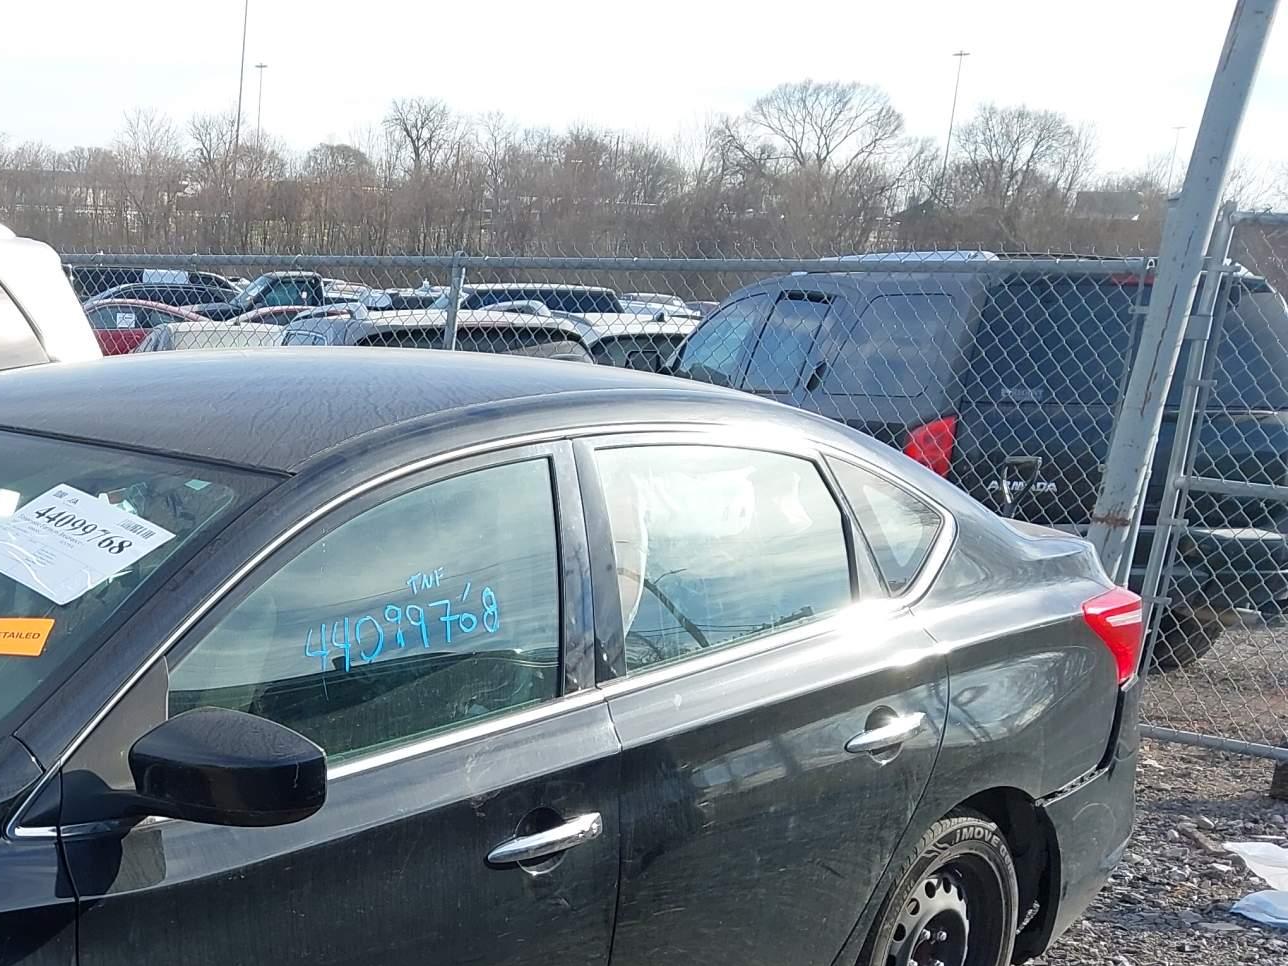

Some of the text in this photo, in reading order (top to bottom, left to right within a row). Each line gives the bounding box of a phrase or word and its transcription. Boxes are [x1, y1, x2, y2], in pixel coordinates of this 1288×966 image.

[33, 505, 133, 555] 44099768
[406, 567, 446, 595] TNF
[304, 582, 500, 673] 44099768
